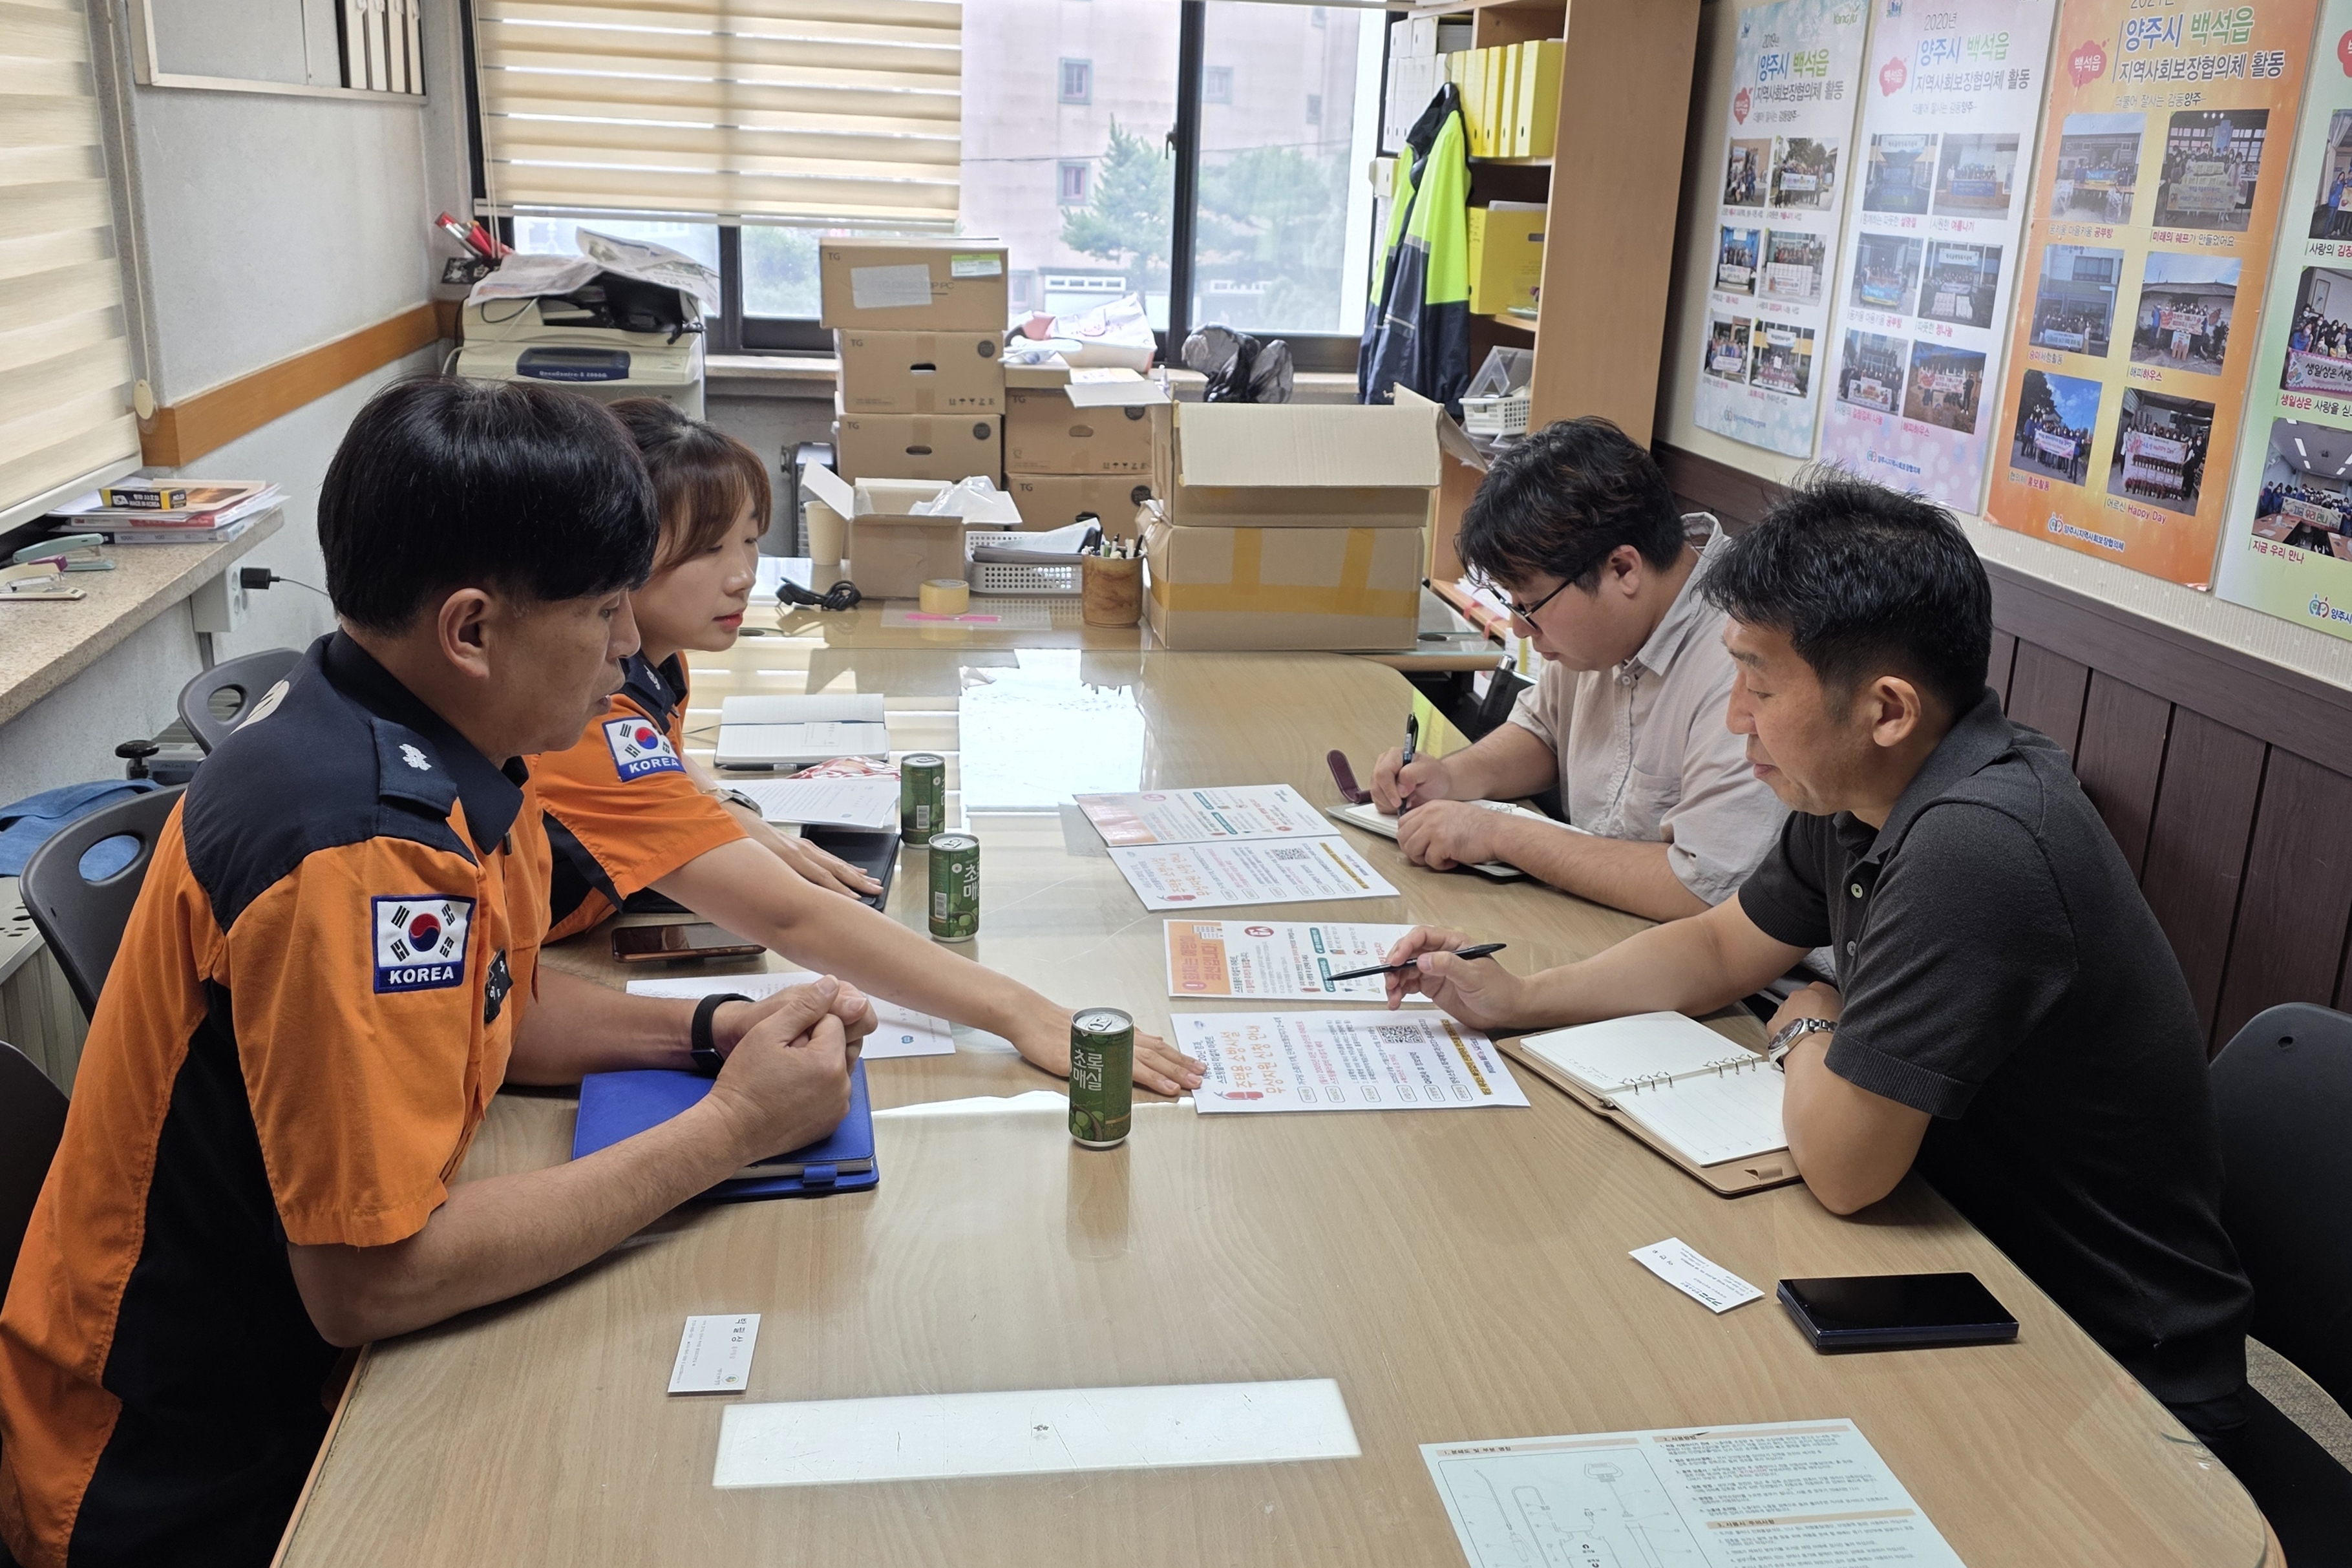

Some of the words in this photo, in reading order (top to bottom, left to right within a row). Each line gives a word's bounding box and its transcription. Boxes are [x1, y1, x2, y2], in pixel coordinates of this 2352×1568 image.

[1924, 12, 1957, 31] 2020년
[2126, 14, 2183, 51] 양주시
[2190, 7, 2254, 45] 백석읍
[1920, 36, 1961, 67] 양주시
[1967, 31, 2009, 62] 백석읍
[1759, 52, 1790, 81] 양주시
[1793, 48, 1829, 78] 백석읍
[2074, 56, 2101, 72] 백석읍
[2119, 54, 2247, 83] 지역사회보장협의체
[2251, 52, 2285, 78] 활동
[1883, 68, 1904, 83] 백석읍
[1915, 69, 2005, 94] 지역사회보장협의체
[2008, 69, 2030, 90] 활동
[1755, 81, 1822, 103] 지역사회보장협의체
[1824, 80, 1844, 100] 활동
[2141, 94, 2165, 107] 잘사는
[1951, 220, 1975, 233] 여름나기
[2094, 228, 2114, 239] 공부방
[2153, 232, 2174, 244] 미래의
[2198, 234, 2235, 247] 만들었어요
[2309, 242, 2335, 257] 사랑의
[1886, 315, 1902, 328] 공부방
[2130, 366, 2163, 382] 해피하우스
[2305, 362, 2338, 380] 생일상은
[1012, 395, 1026, 404] TG
[2281, 394, 2312, 410] 생일상은
[2315, 401, 2339, 416] 사랑을
[1019, 483, 1033, 492] TG
[2028, 475, 2051, 492] 홍보활동
[2106, 498, 2127, 513] 어르신
[2128, 504, 2151, 521] Happy
[2152, 511, 2167, 525] Day
[2305, 509, 2316, 520] 우리
[2064, 525, 2125, 551] 양주시지역사회보장협의체
[2252, 540, 2268, 554] 지금
[2271, 545, 2286, 560] 우리
[2289, 549, 2305, 565] 만나
[629, 759, 679, 774] KOREA
[963, 863, 979, 883] 초
[963, 882, 979, 901] 매
[389, 966, 454, 984] KOREA
[1242, 1024, 1267, 1040] 안내
[1195, 1050, 1207, 1061] 20년
[1208, 1048, 1221, 1061] 미설치
[1219, 1031, 1249, 1062] 소방시설
[1249, 1043, 1275, 1058] 신청
[1074, 1049, 1104, 1073] 초록
[1311, 1059, 1324, 1073] 2005년
[1073, 1068, 1103, 1091] 매실
[1213, 1062, 1228, 1084] 스프링클러
[1230, 1065, 1258, 1088] 주택용
[1255, 1061, 1289, 1094] 무상지원
[1295, 1074, 1308, 1085] 가구당
